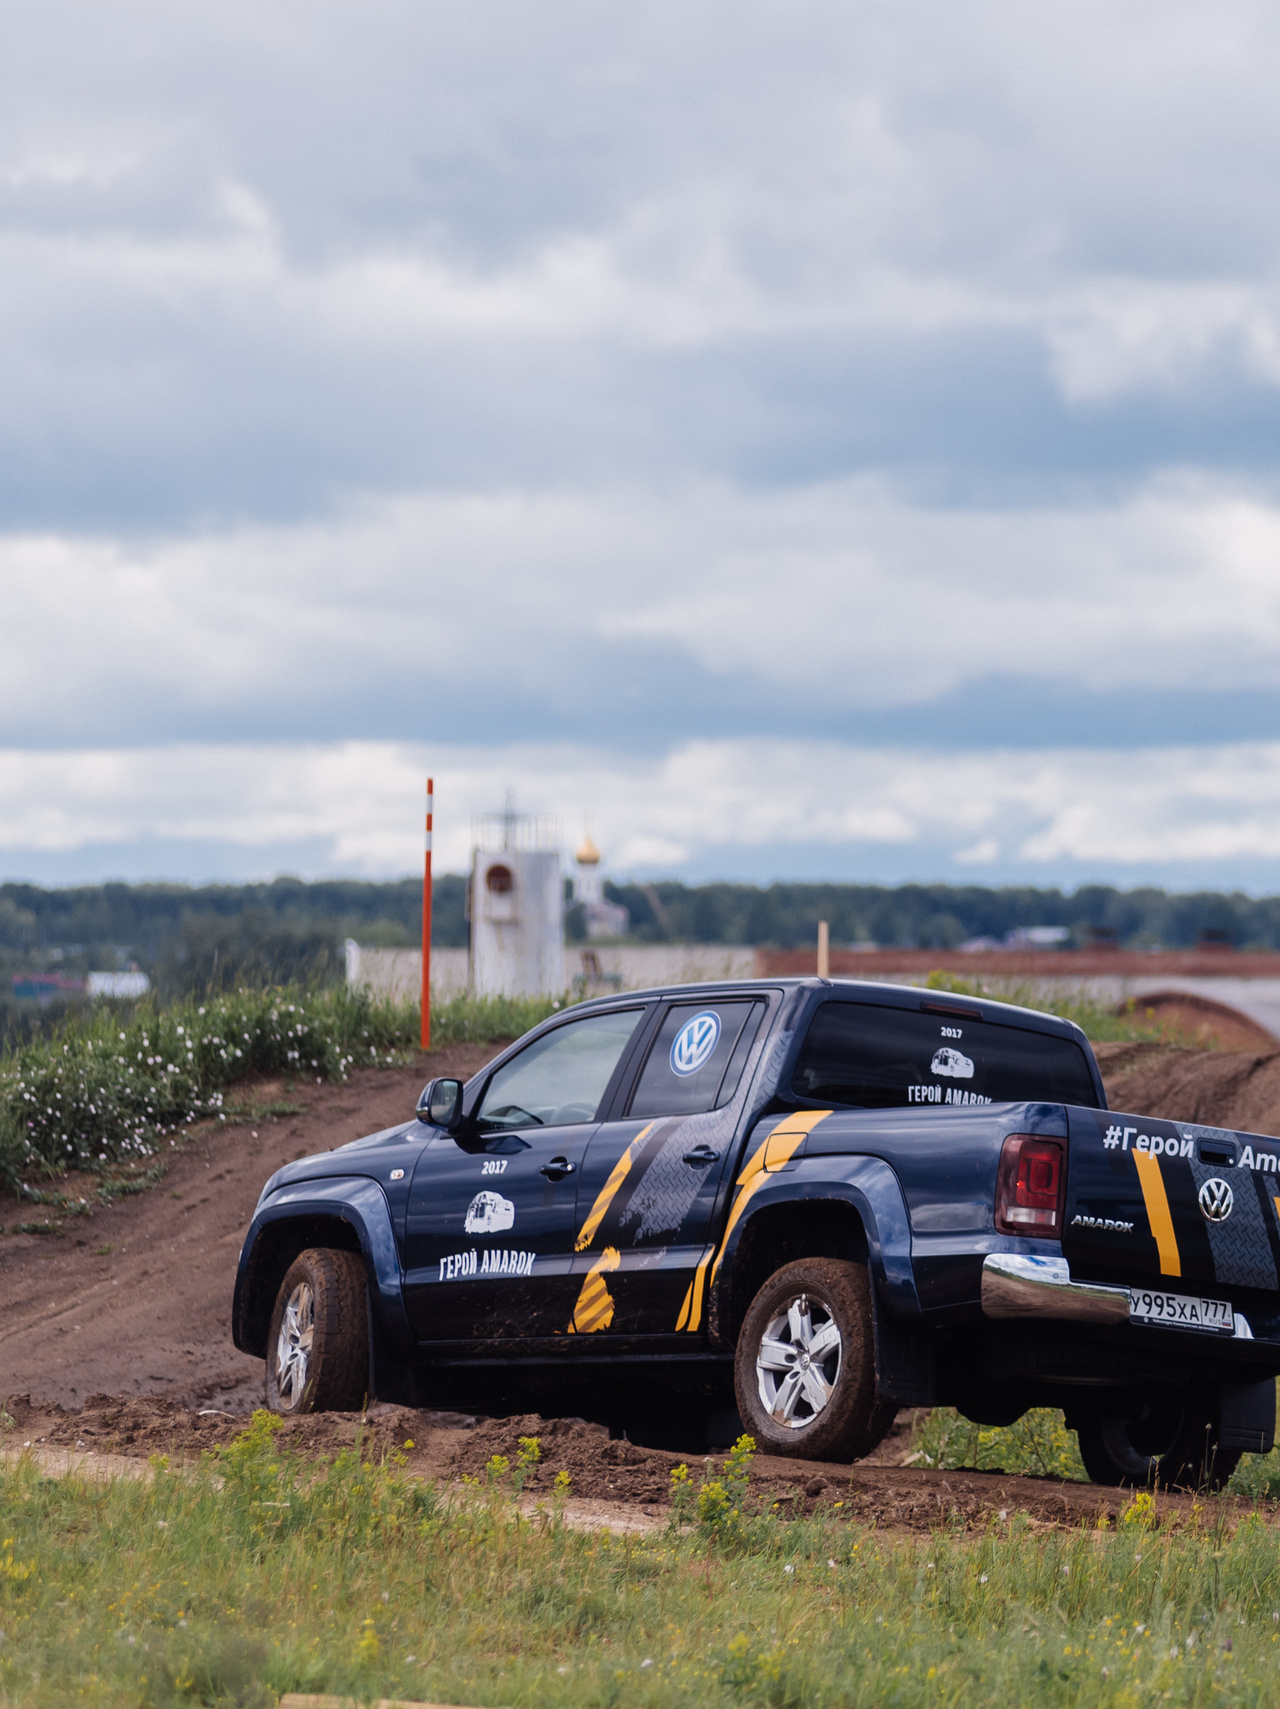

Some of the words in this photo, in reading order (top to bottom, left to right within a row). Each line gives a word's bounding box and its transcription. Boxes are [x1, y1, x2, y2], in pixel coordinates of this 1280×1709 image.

[940, 1026, 963, 1039] 2017
[908, 1084, 942, 1103] ГЕРОЙ
[1102, 1125, 1195, 1160] #Герой
[481, 1160, 508, 1175] 2017
[1070, 1214, 1135, 1234] AMAROK
[439, 1248, 478, 1281] ГЕРОЙ
[480, 1249, 536, 1276] AMAROK
[1208, 1317, 1222, 1326] RUS
